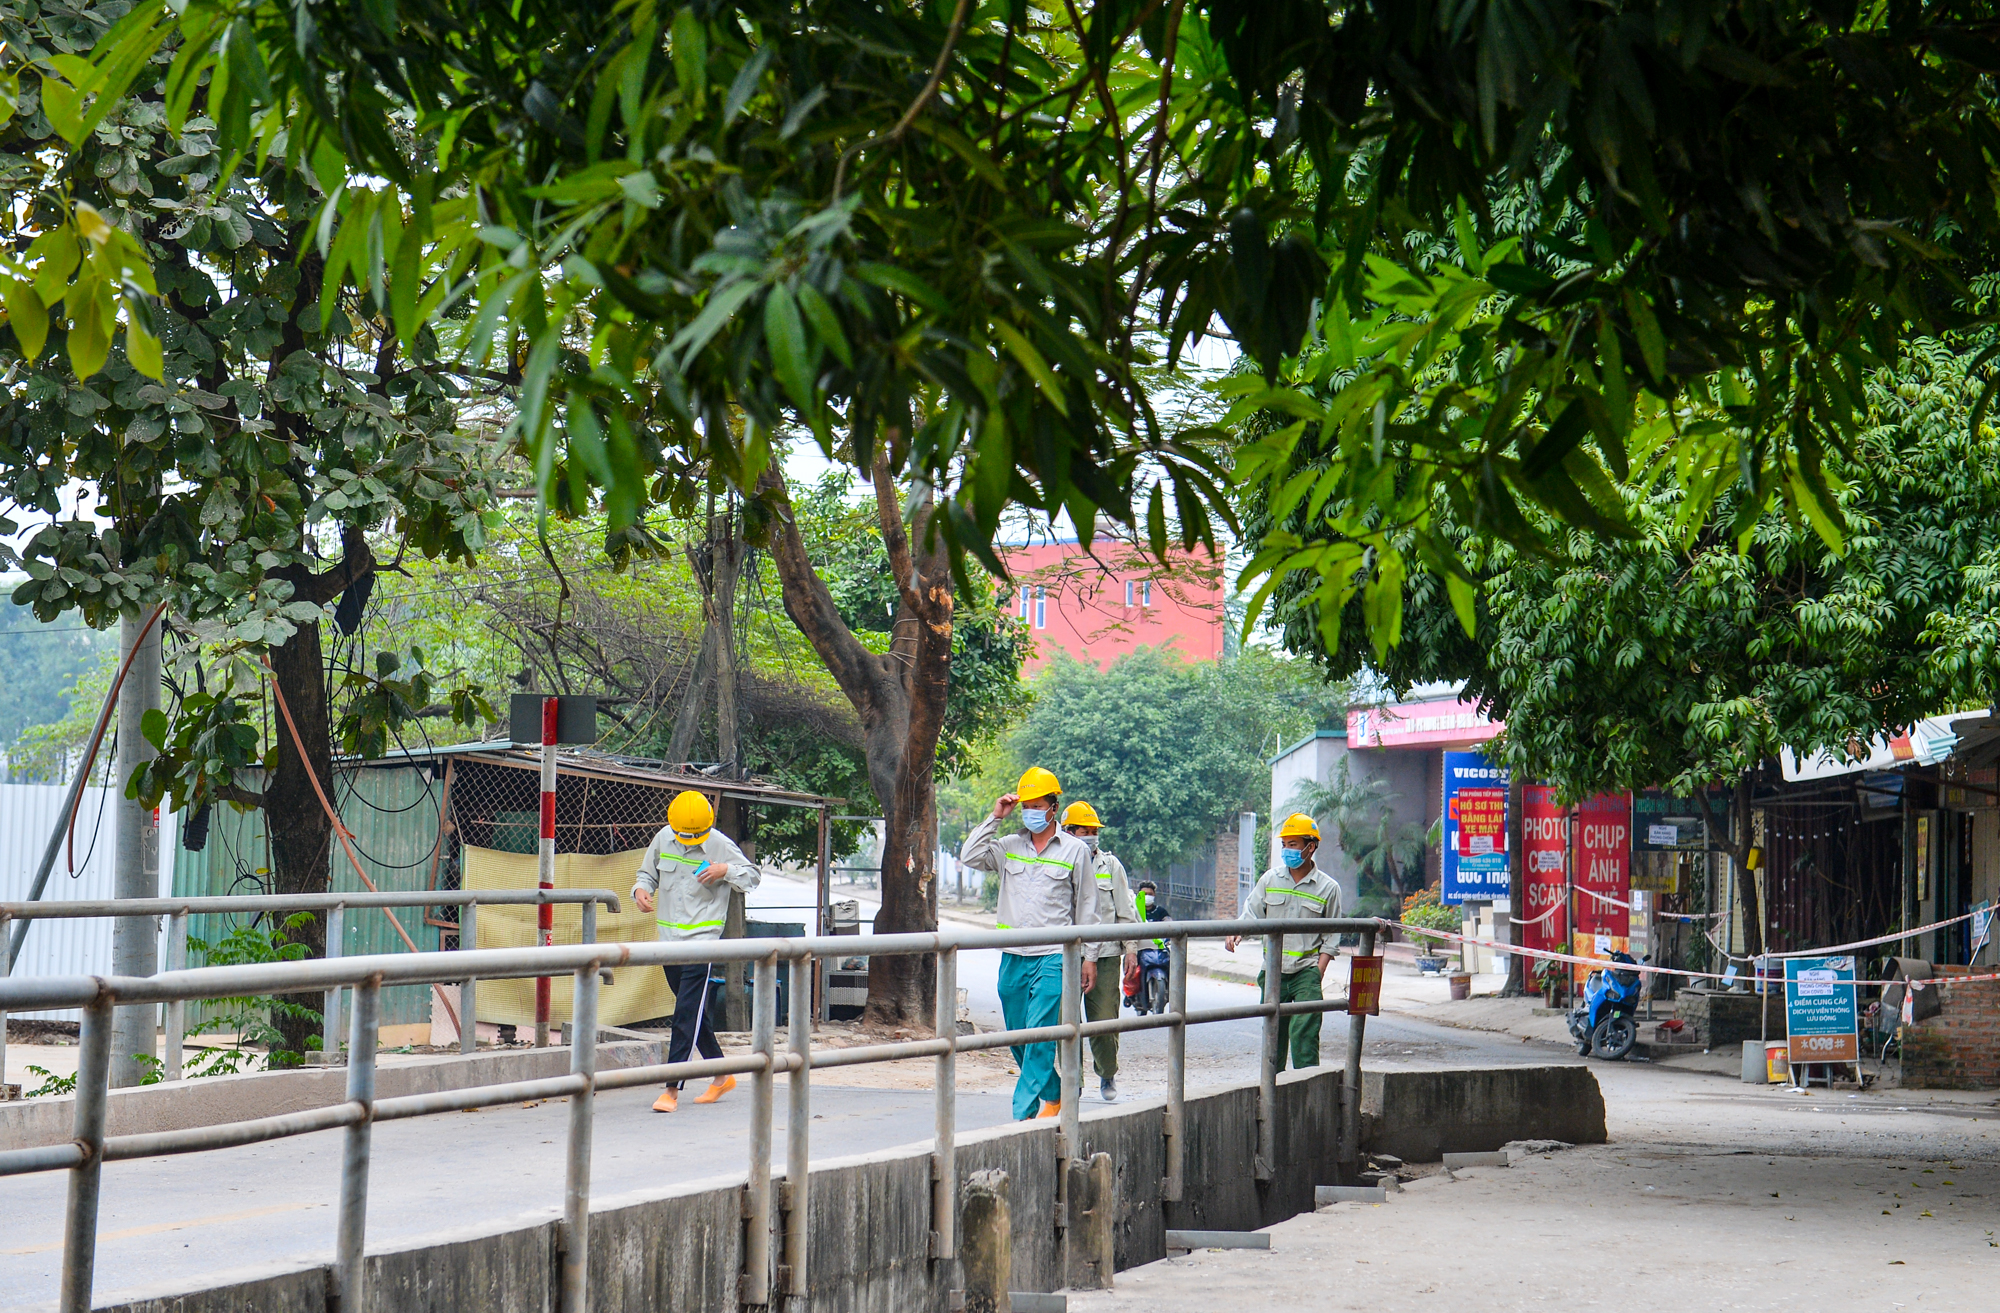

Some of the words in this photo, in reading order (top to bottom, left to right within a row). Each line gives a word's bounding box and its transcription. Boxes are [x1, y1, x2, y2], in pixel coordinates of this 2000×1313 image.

[1526, 791, 1543, 805] ANH
[1474, 800, 1487, 811] SƠ
[1489, 801, 1503, 811] THI
[1488, 812, 1503, 823] LÁI
[1464, 824, 1476, 834] XE
[1478, 823, 1499, 834] MÁY
[1584, 825, 1625, 855] CHỤP
[1588, 853, 1620, 882] ẢNH
[1529, 883, 1566, 906] SCAN
[1591, 885, 1618, 915] THẺ
[1794, 998, 1812, 1006] ĐIỂM
[1834, 996, 1847, 1005] CẤP
[1819, 1014, 1837, 1022] ĐỘNG
